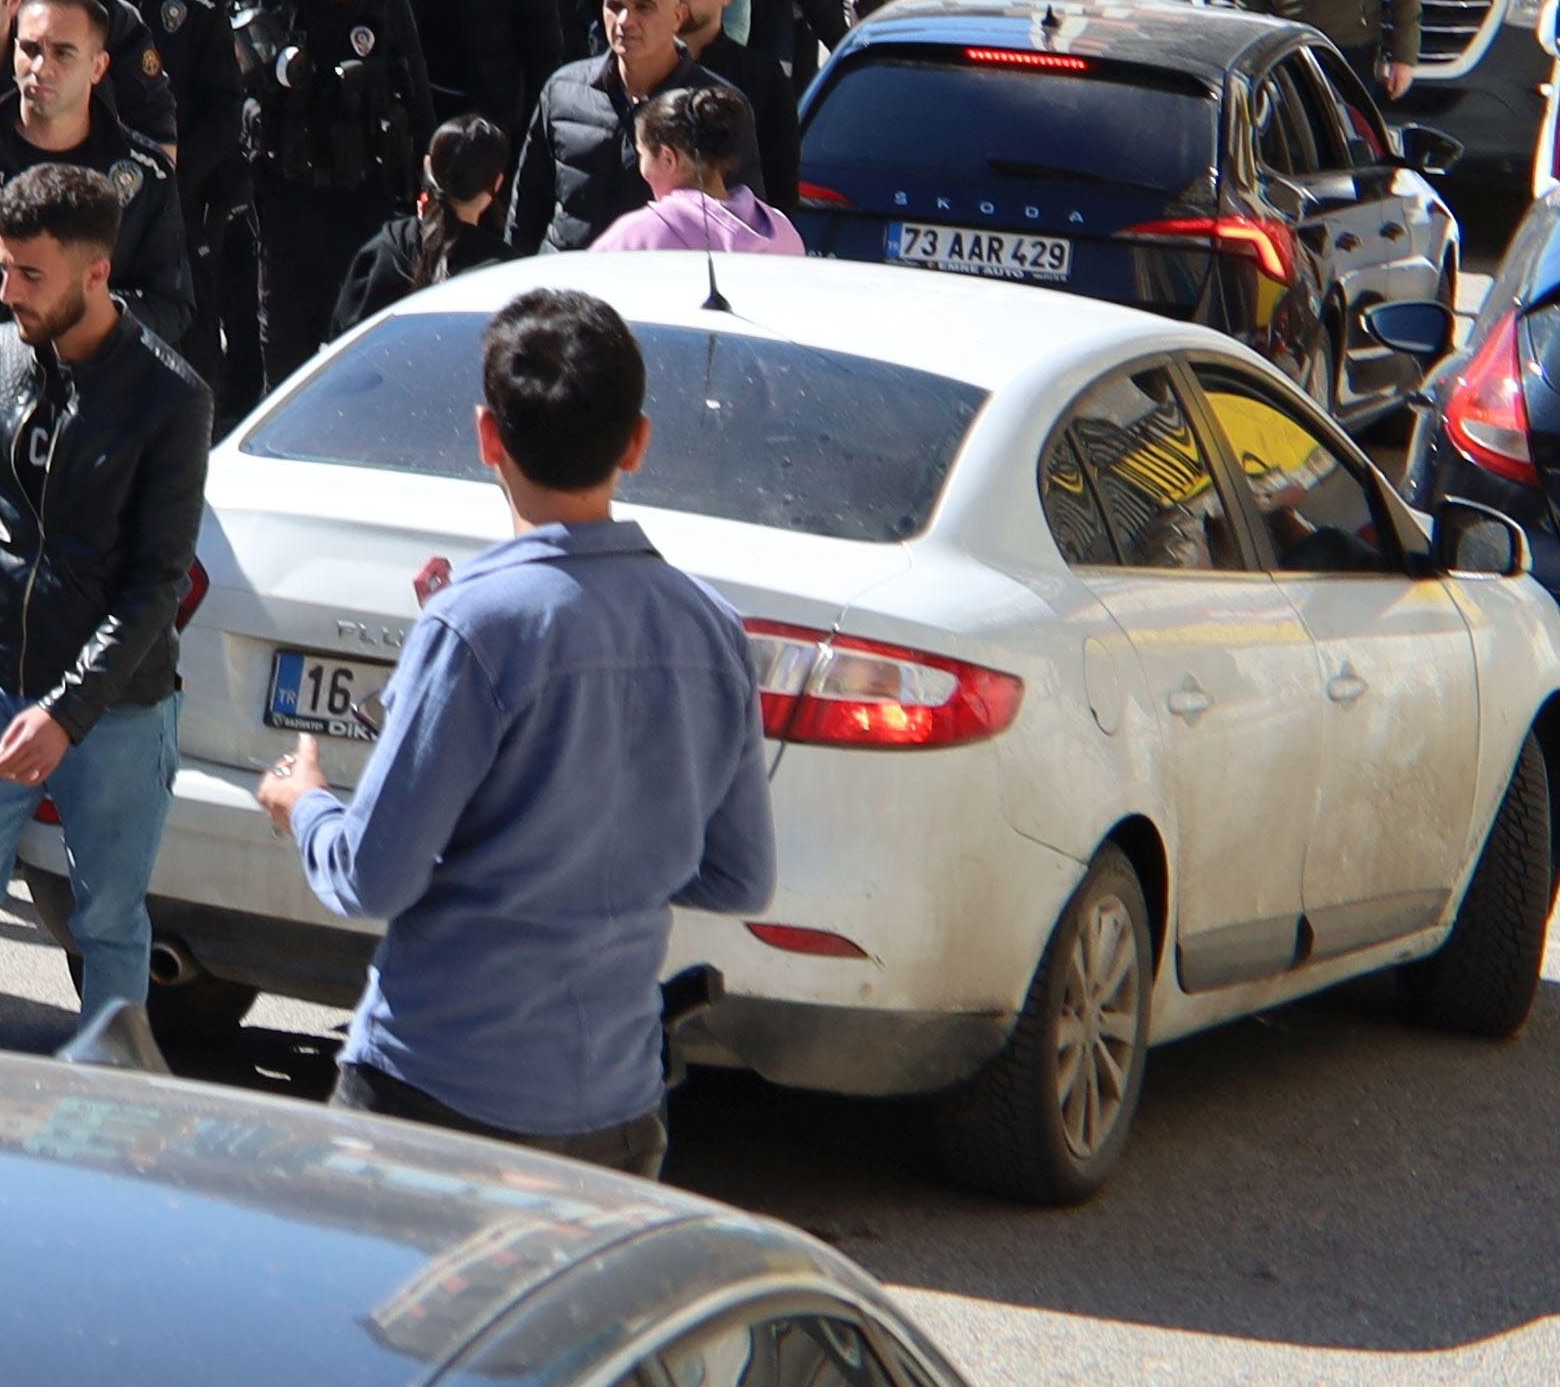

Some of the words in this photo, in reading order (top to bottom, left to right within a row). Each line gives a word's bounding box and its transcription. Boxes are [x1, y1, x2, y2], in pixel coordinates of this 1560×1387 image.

[903, 227, 938, 256] 73
[948, 230, 1004, 264] AAR
[1011, 238, 1067, 270] 429
[307, 664, 355, 716] 16
